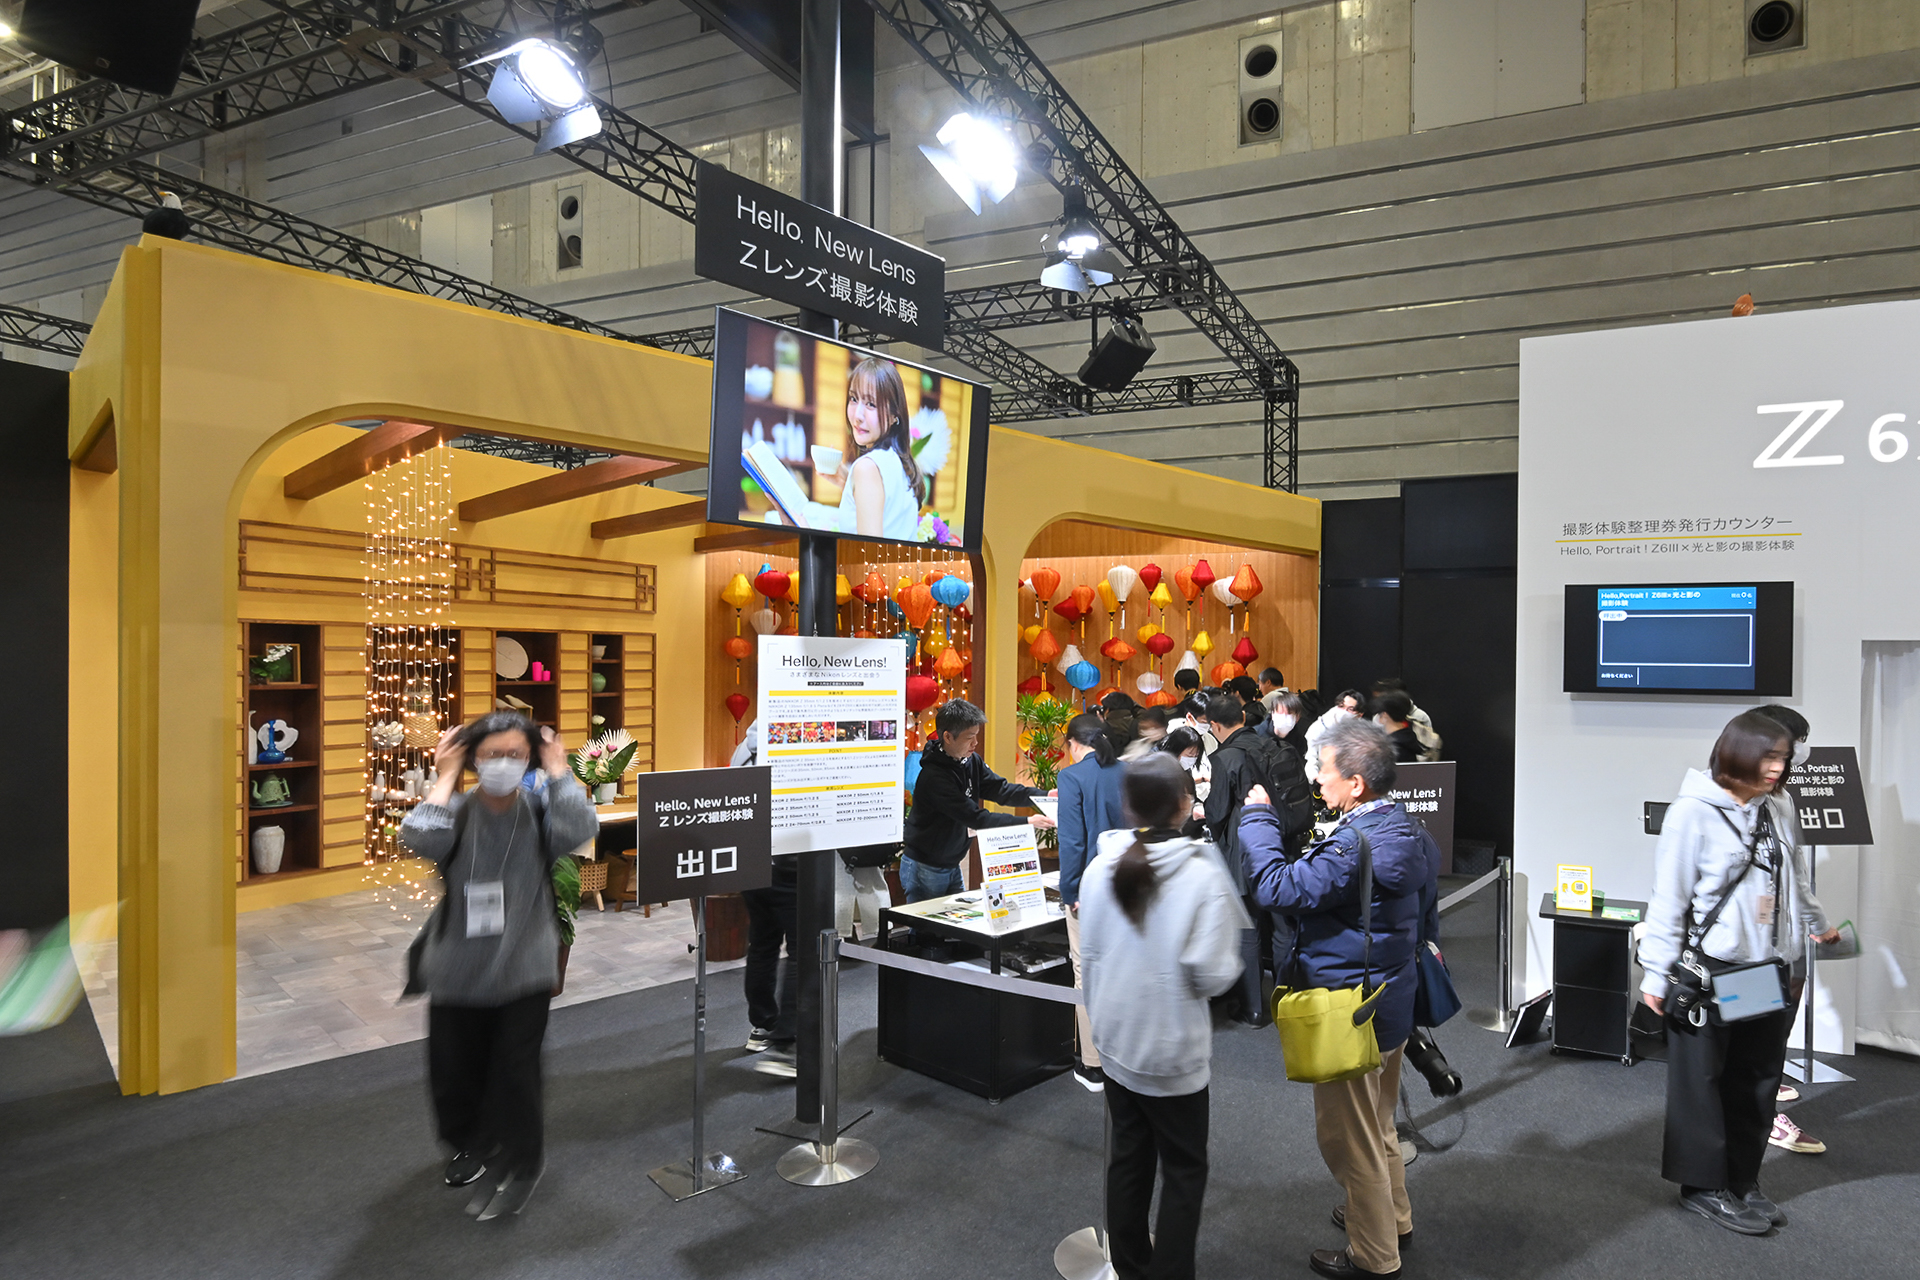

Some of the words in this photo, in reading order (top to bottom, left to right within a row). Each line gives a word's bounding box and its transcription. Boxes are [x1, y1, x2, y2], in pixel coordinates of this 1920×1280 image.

[815, 226, 864, 265] New
[869, 247, 916, 285] Lens
[1563, 516, 1792, 536] 撮影体験整理券発行カウンター
[1560, 546, 1592, 556] Hello,
[782, 655, 821, 669] Hello,
[824, 655, 852, 667] New
[854, 656, 887, 668] Lens!
[655, 799, 691, 813] Hello,
[694, 797, 722, 809] New
[1799, 807, 1845, 829] 出口
[676, 846, 737, 879] 出口
